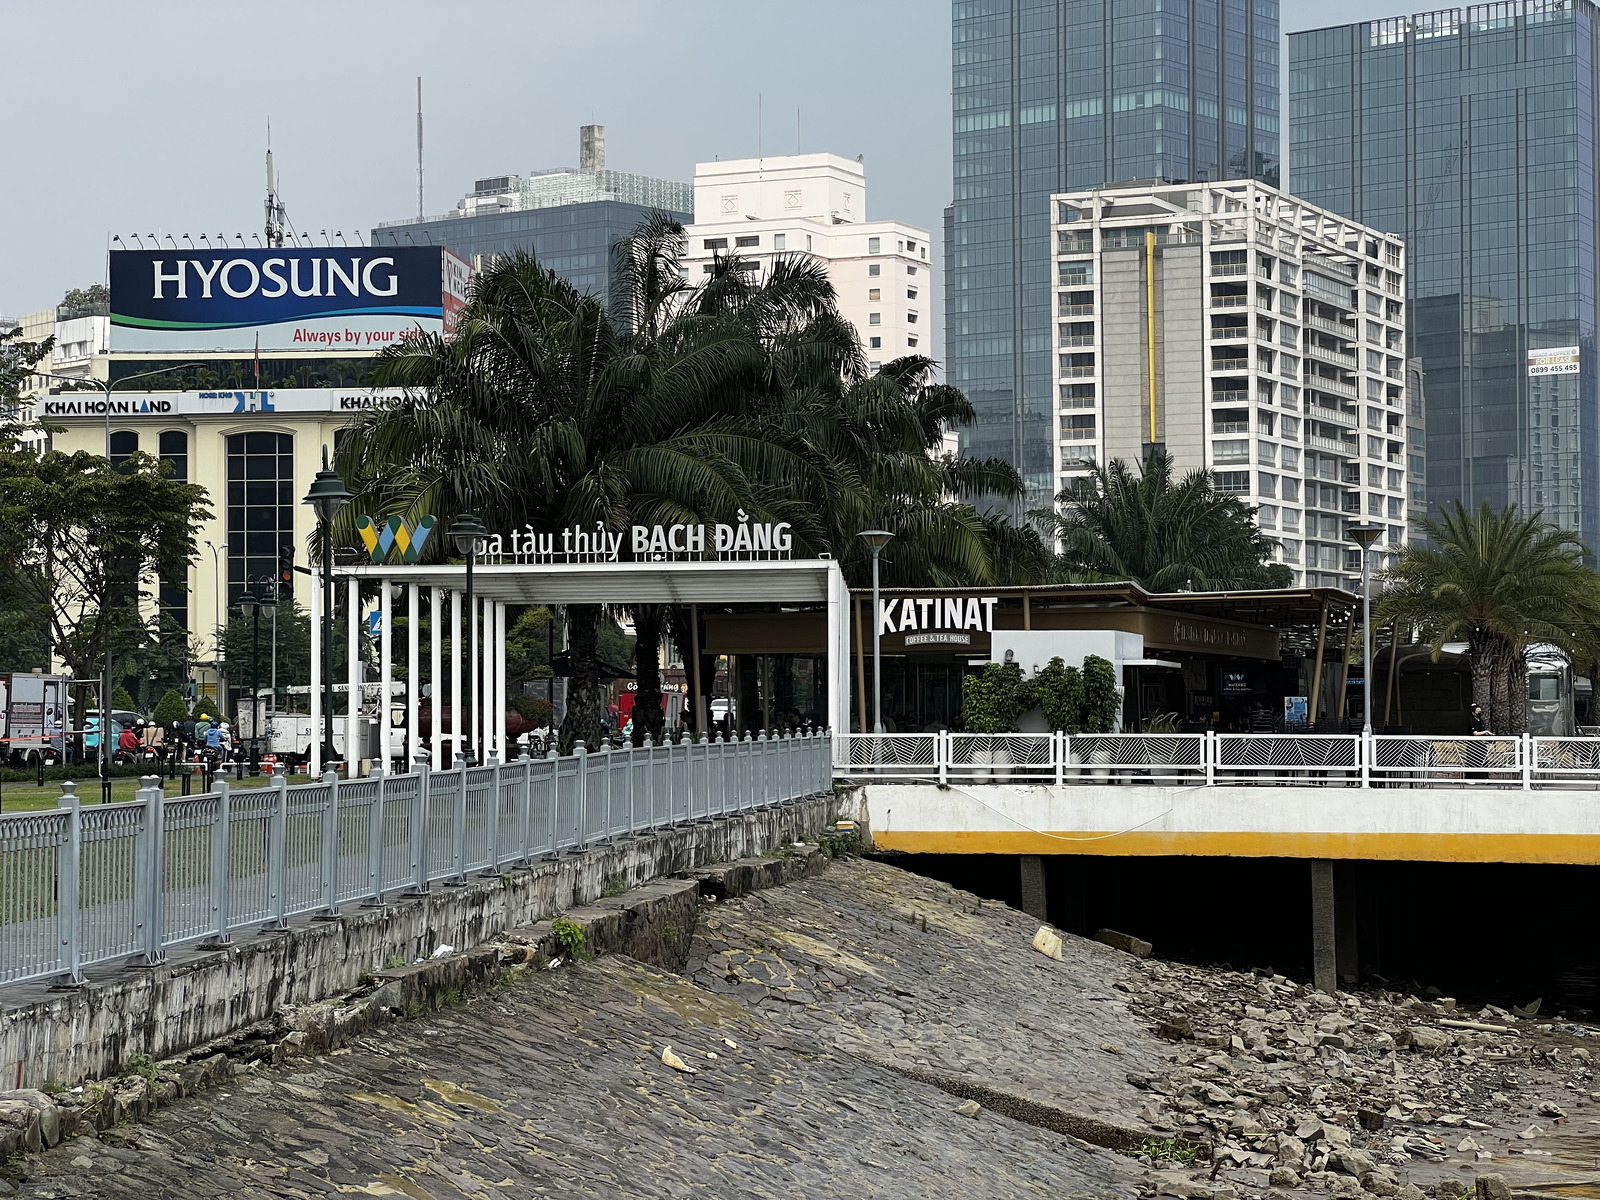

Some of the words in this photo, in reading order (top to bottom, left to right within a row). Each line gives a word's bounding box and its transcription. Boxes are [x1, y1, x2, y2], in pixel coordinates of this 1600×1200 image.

[152, 257, 398, 299] HYOSUNG
[293, 328, 341, 345] Always
[345, 328, 361, 345] by
[365, 330, 395, 344] your
[44, 401, 82, 414] KHAI
[84, 401, 129, 413] HOAN
[132, 398, 171, 413] LAND
[510, 523, 553, 555] tàu
[562, 520, 623, 562] thủy
[713, 508, 792, 552] ĐẰNG
[878, 597, 998, 636] KATINAT
[906, 634, 928, 644] COFFEE
[929, 634, 935, 642] &
[936, 634, 948, 642] TEA
[949, 634, 969, 643] HOUSE
